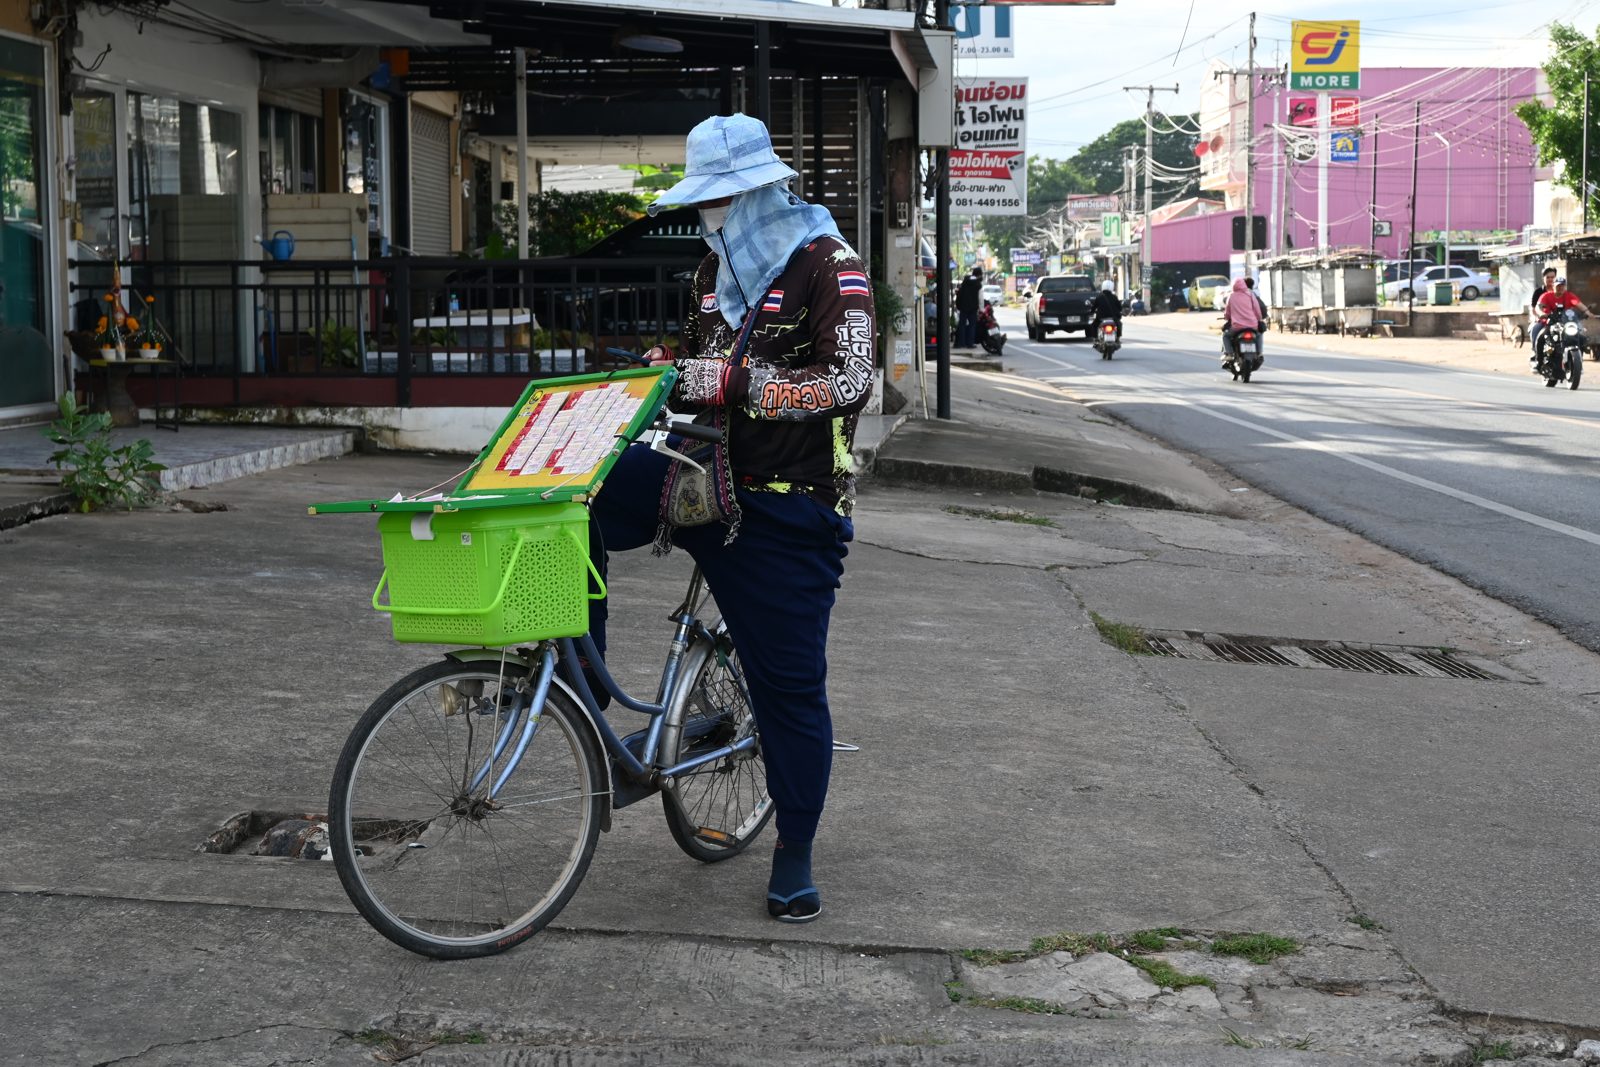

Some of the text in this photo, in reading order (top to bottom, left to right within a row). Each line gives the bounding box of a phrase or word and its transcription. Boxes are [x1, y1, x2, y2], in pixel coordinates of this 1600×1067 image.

[1300, 75, 1350, 87] MORE
[969, 104, 1024, 124] ไอโฟน
[959, 124, 1019, 142] อนแก่น
[955, 198, 1020, 207] 081-4491556
[1103, 215, 1120, 237] ยา
